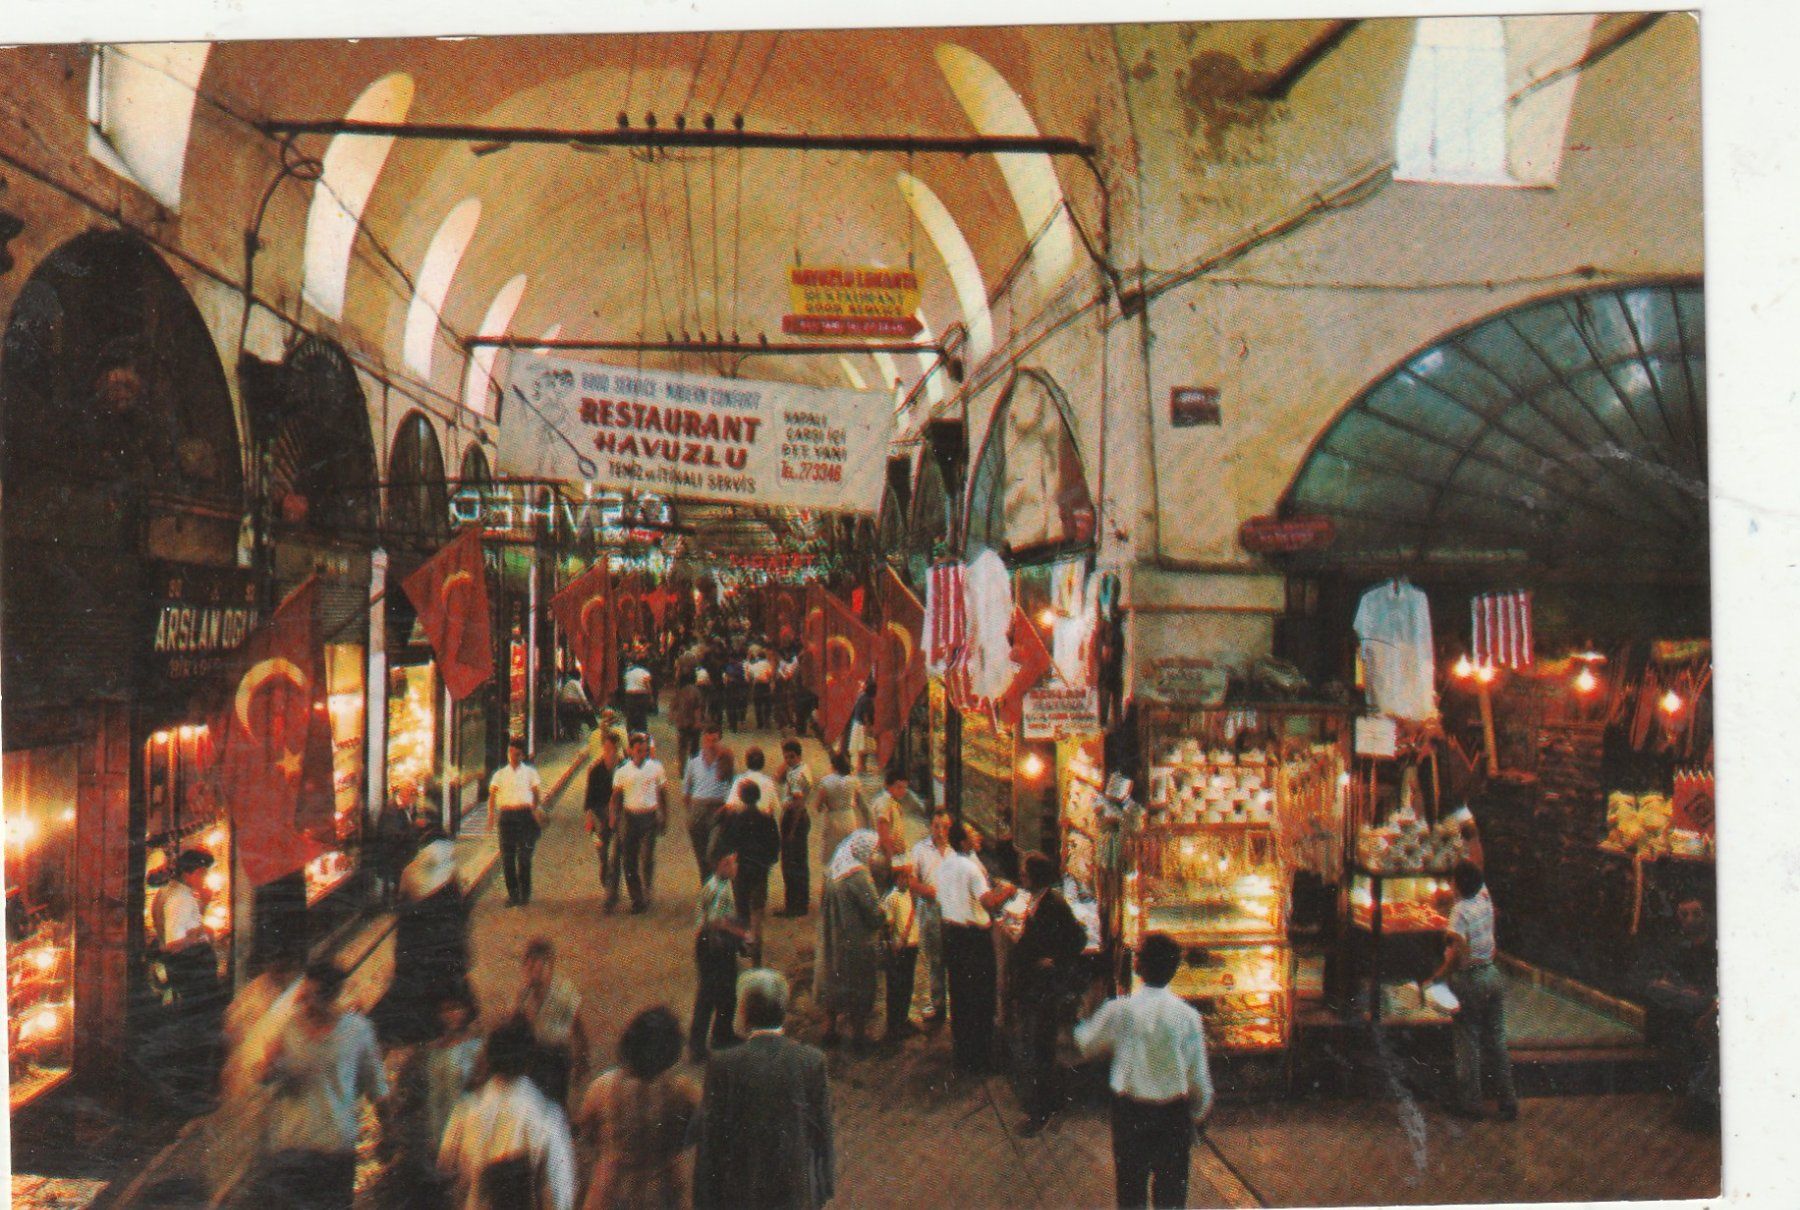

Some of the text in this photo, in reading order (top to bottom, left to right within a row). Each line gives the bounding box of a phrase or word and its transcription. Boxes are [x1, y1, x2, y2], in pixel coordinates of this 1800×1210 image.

[579, 397, 762, 444] RESTAURANT
[593, 430, 749, 470] HAVUZLU
[154, 608, 221, 652] ARSLAN
